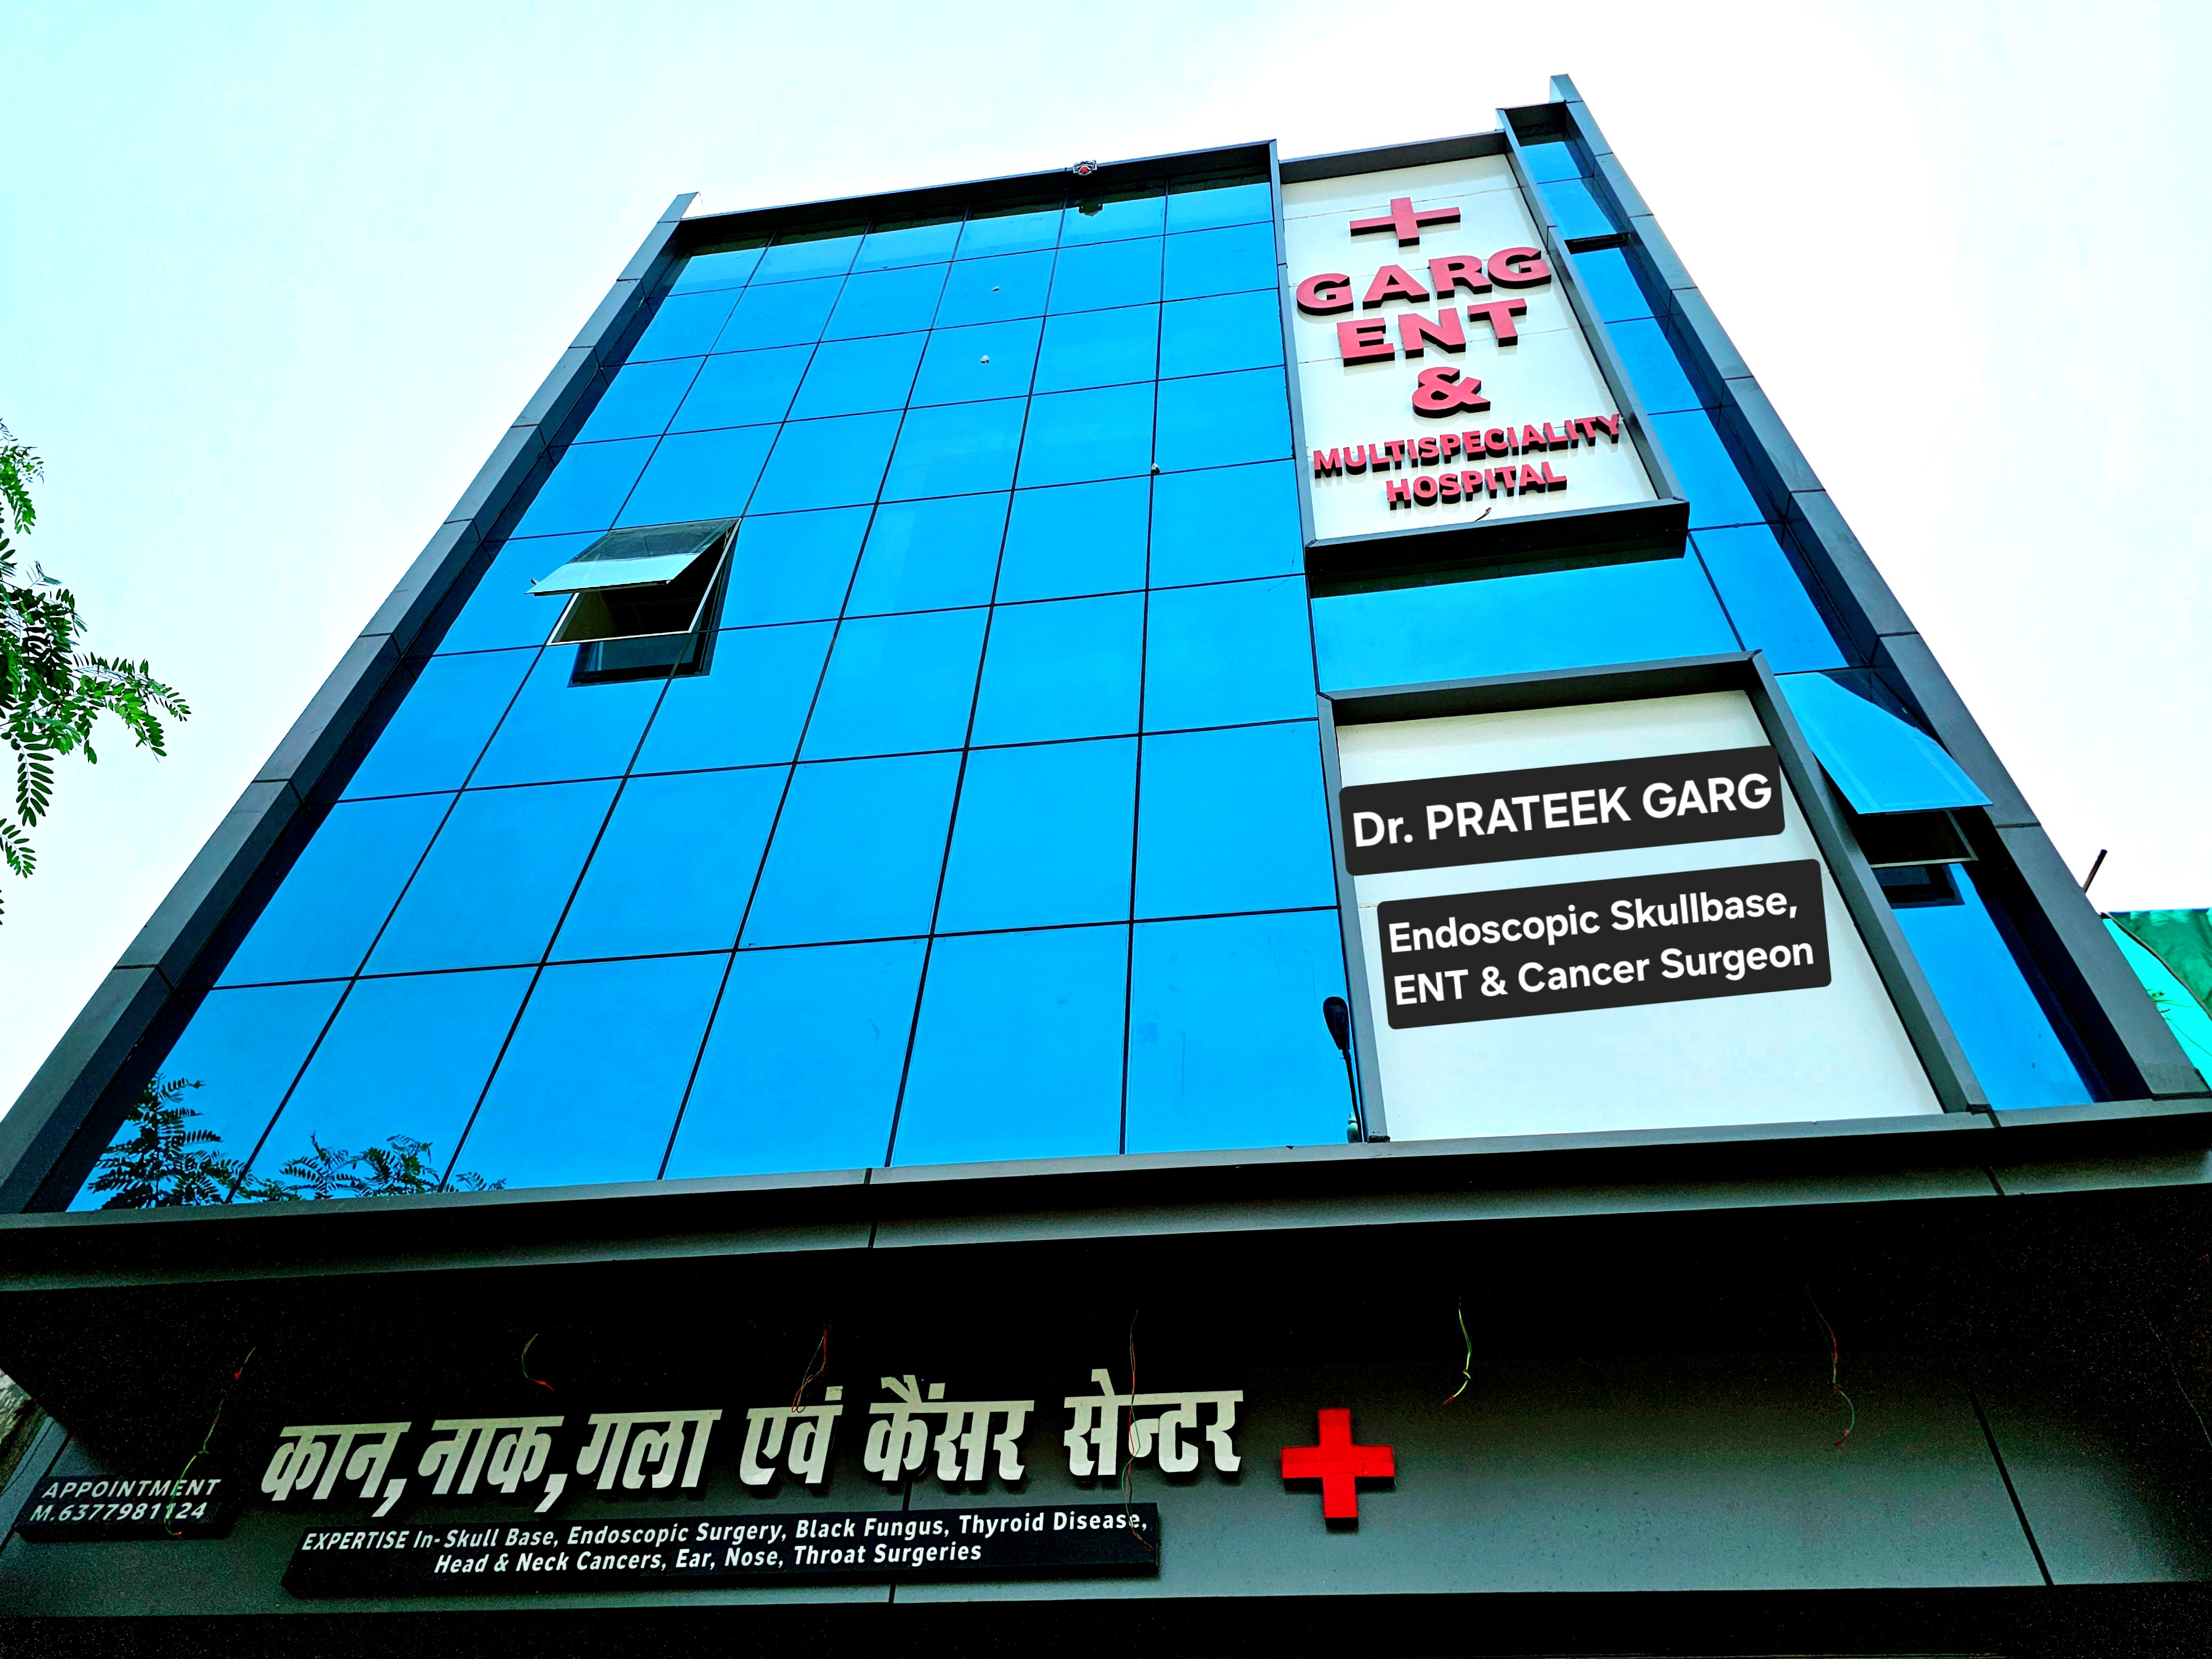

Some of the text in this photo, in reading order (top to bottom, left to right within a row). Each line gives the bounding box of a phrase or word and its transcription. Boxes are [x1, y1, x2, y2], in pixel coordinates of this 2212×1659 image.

[1296, 247, 1551, 316] GARG
[1337, 298, 1527, 367] ENT
[1412, 367, 1491, 419] &
[1313, 414, 1620, 479] MULTISPECIALITY
[1386, 461, 1567, 510] HOSPITAL
[739, 1386, 844, 1485] एवं
[863, 1375, 1034, 1481] कैंसर
[1063, 1368, 1243, 1476] सेन्टर
[29, 1502, 208, 1521] M.6377981124
[41, 1479, 222, 1499] APPOINTMENT
[301, 1511, 1147, 1550] EXPERTISE In- Skull Base, Endoscopic Surgery, Black Fungus, Thyroid Disease,
[434, 1541, 981, 1573] Head & Neck Cancers, Ear, Nose, Throat Surgeries
